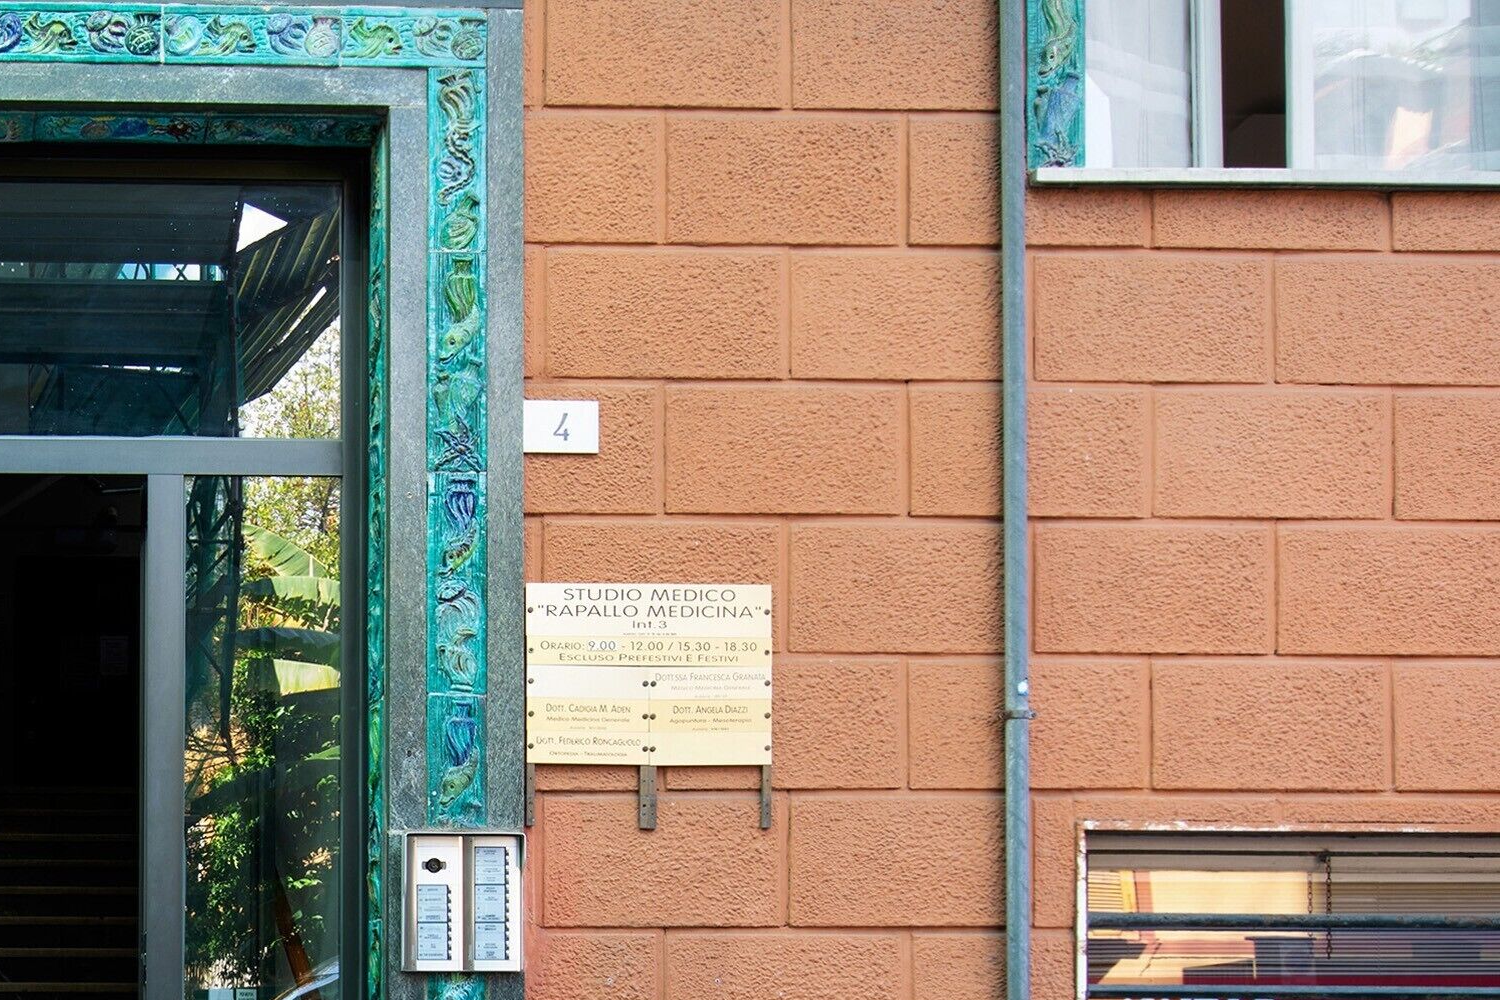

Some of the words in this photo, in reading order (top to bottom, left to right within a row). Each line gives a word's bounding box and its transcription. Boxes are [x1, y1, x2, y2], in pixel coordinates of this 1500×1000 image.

[553, 412, 570, 441] 4
[563, 588, 642, 601] STUDIO
[650, 589, 736, 602] MEDICO
[537, 604, 639, 617] "RAPALLO
[646, 605, 762, 618] MEDICINA"
[588, 641, 616, 651] 9.00
[630, 641, 664, 651] 12.00
[678, 641, 711, 651] 15.30
[724, 641, 758, 652] 18.30
